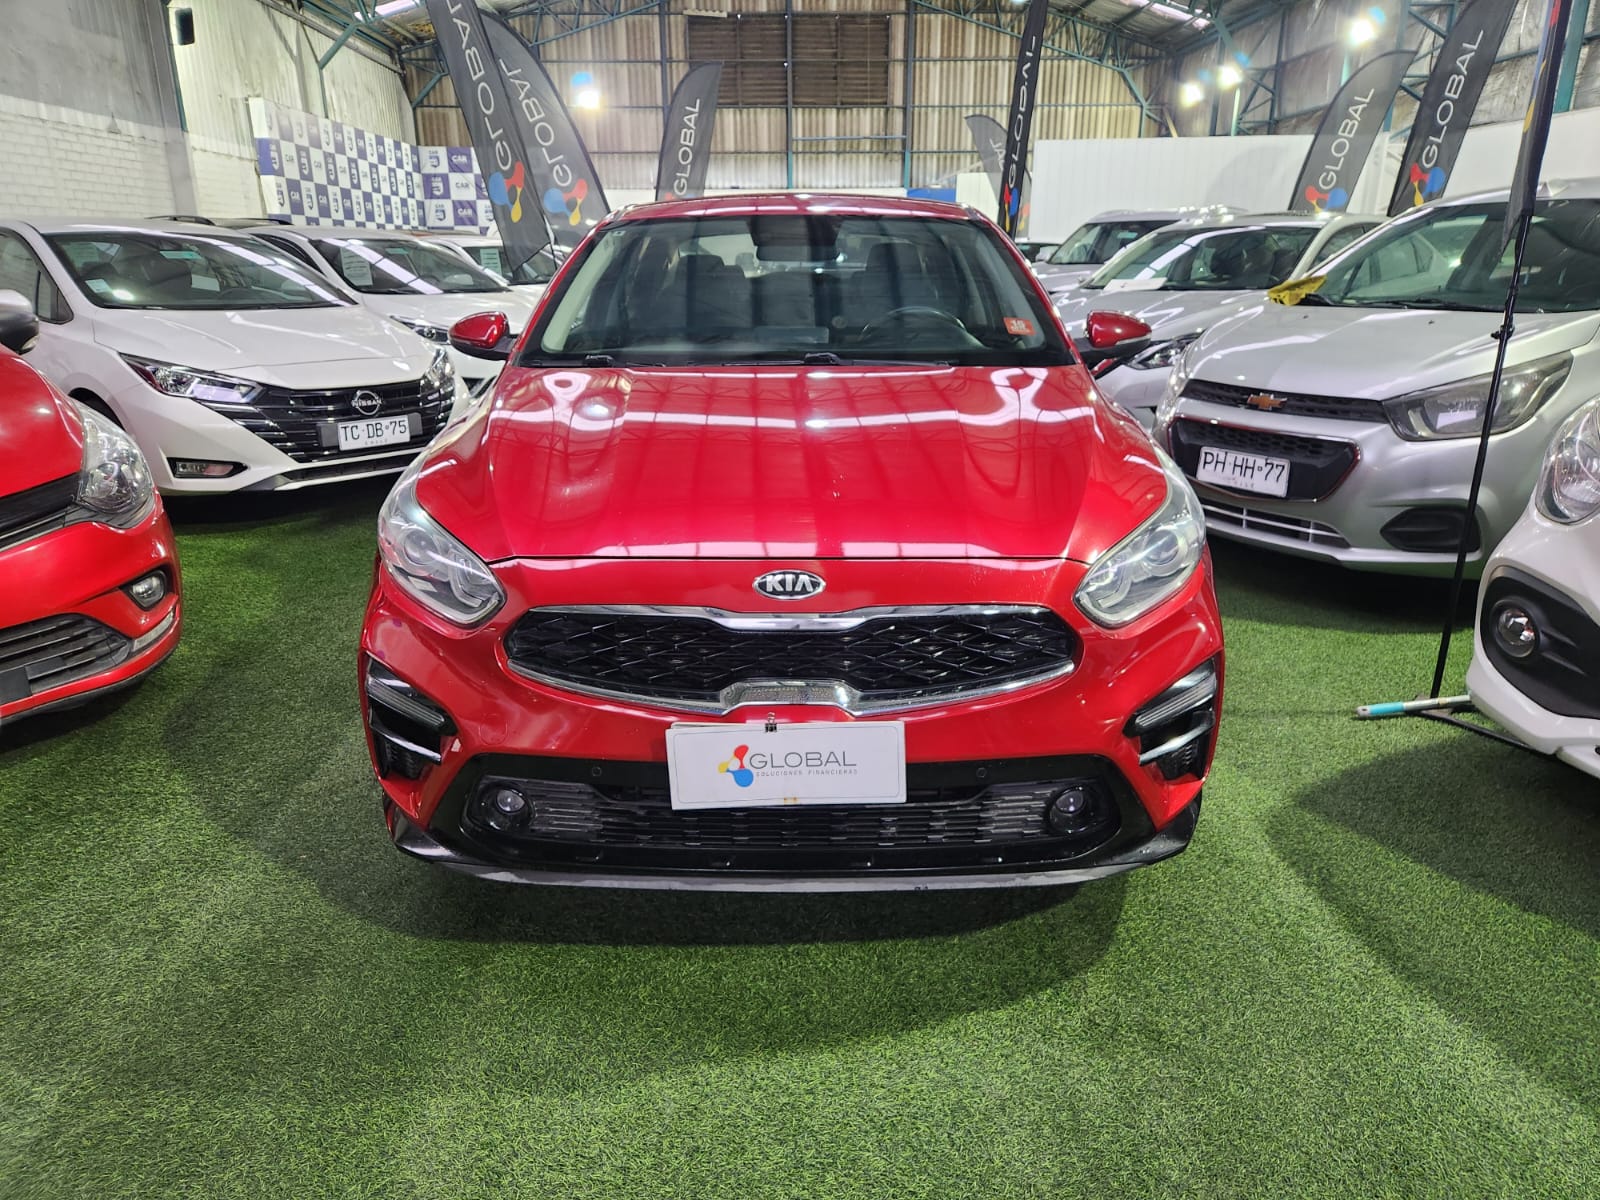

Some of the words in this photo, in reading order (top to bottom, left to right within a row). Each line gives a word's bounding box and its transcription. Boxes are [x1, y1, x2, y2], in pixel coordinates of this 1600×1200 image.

[673, 98, 700, 196] GLOBAL
[1318, 87, 1375, 190] GLOBAL
[1422, 29, 1484, 168] GLOBAL
[766, 574, 814, 592] KIA
[749, 751, 857, 769] GLOBAL
